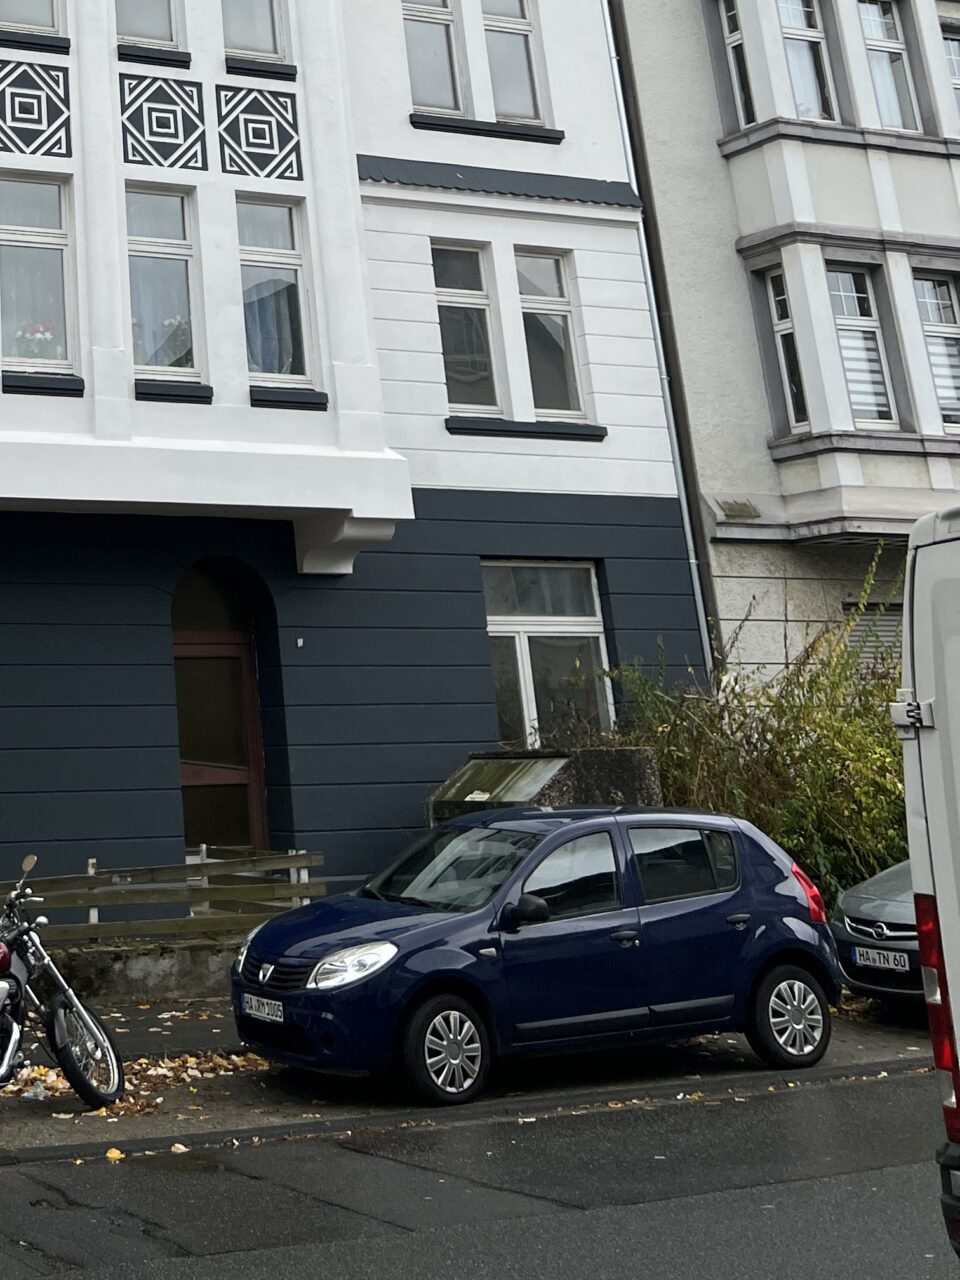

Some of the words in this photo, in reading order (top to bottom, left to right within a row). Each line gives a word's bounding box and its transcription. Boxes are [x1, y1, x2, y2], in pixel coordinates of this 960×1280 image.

[858, 949, 871, 963] HA
[876, 951, 890, 966] TN
[893, 953, 907, 968] 60
